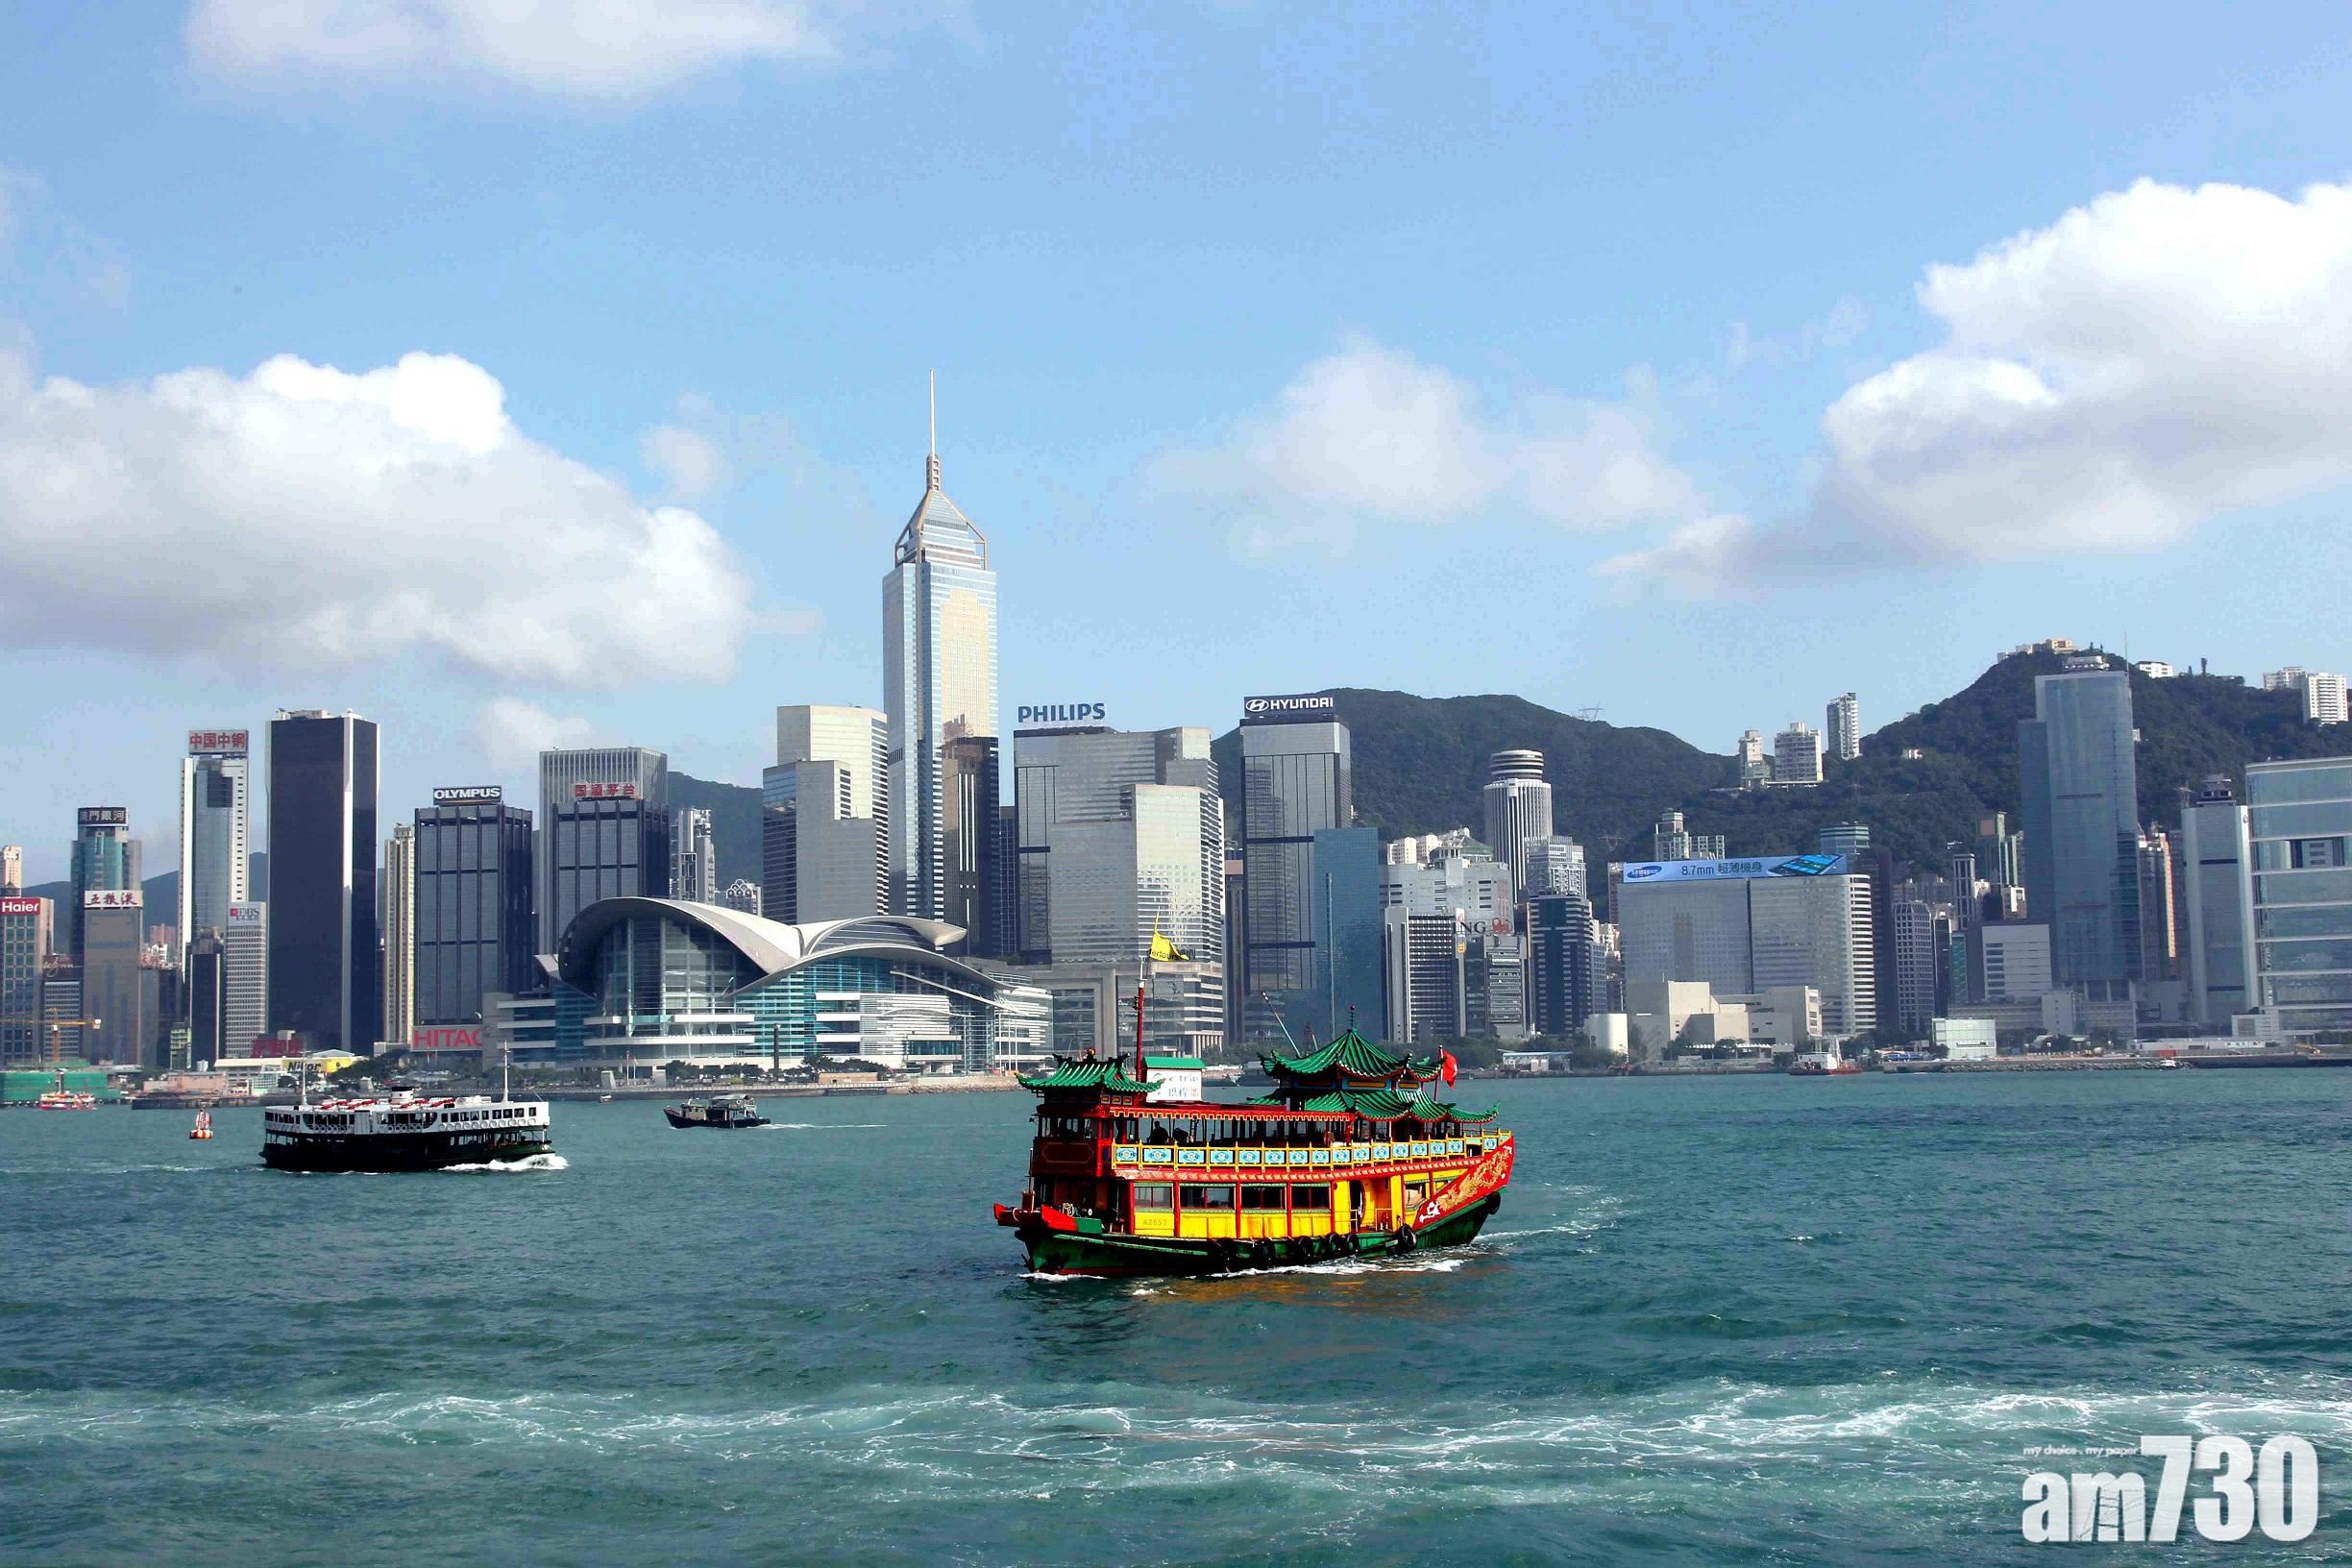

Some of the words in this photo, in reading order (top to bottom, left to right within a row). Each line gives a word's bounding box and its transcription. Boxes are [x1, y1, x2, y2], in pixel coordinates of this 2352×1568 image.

[1270, 697, 1334, 710] HYUNDAI
[1017, 702, 1106, 723] PHILIPS
[433, 787, 501, 799] OLYMPUS
[1681, 865, 1714, 876] 8.7mm
[2, 901, 39, 913] Haier
[239, 908, 259, 917] DBS
